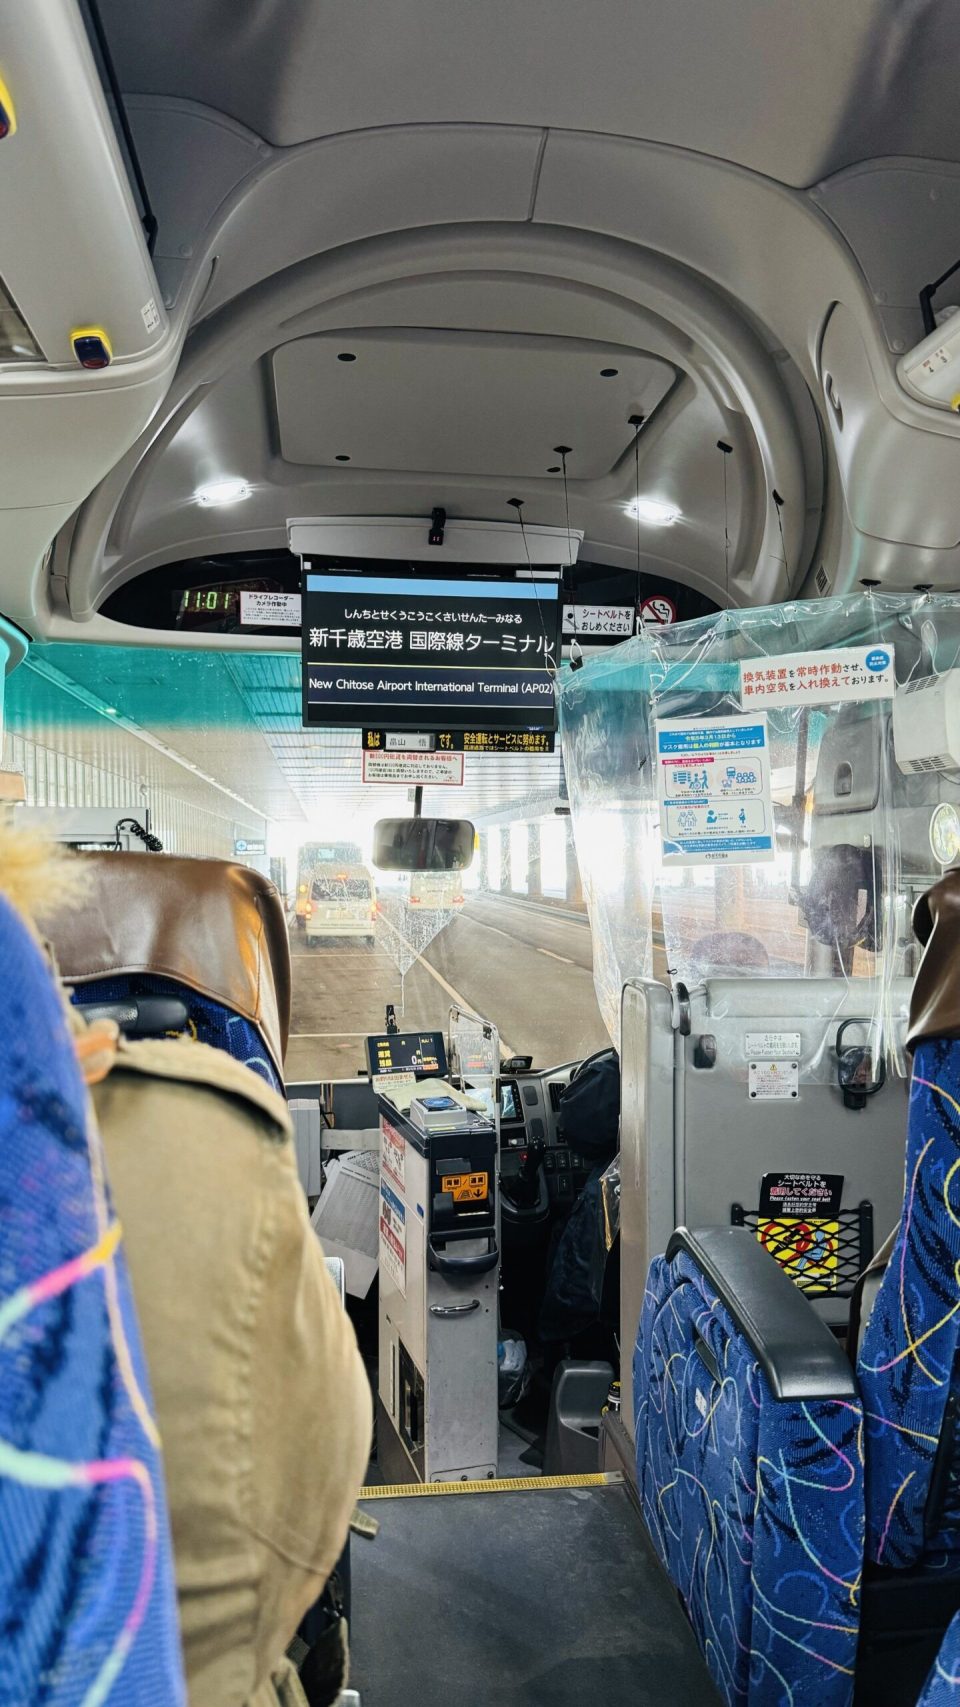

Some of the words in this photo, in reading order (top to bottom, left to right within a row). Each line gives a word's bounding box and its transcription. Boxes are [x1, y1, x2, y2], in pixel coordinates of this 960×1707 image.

[183, 590, 230, 609] 11:01
[344, 608, 523, 624] しんちとせくうこうこくさいせんたーみなる
[582, 608, 632, 620] シートベルトを
[581, 621, 630, 632] おしめください
[309, 627, 403, 650] 新千歳空港
[409, 630, 555, 653] 国際線ターミナル
[743, 662, 864, 683] 換気装置を常時作動させ、
[309, 678, 333, 689] New
[336, 678, 375, 690] Chitose
[377, 680, 412, 692] Airport
[415, 680, 475, 693] International
[478, 682, 519, 693] Terminal
[521, 683, 554, 695] (AP02)
[744, 674, 889, 695] 車内空気を入れ換えております。
